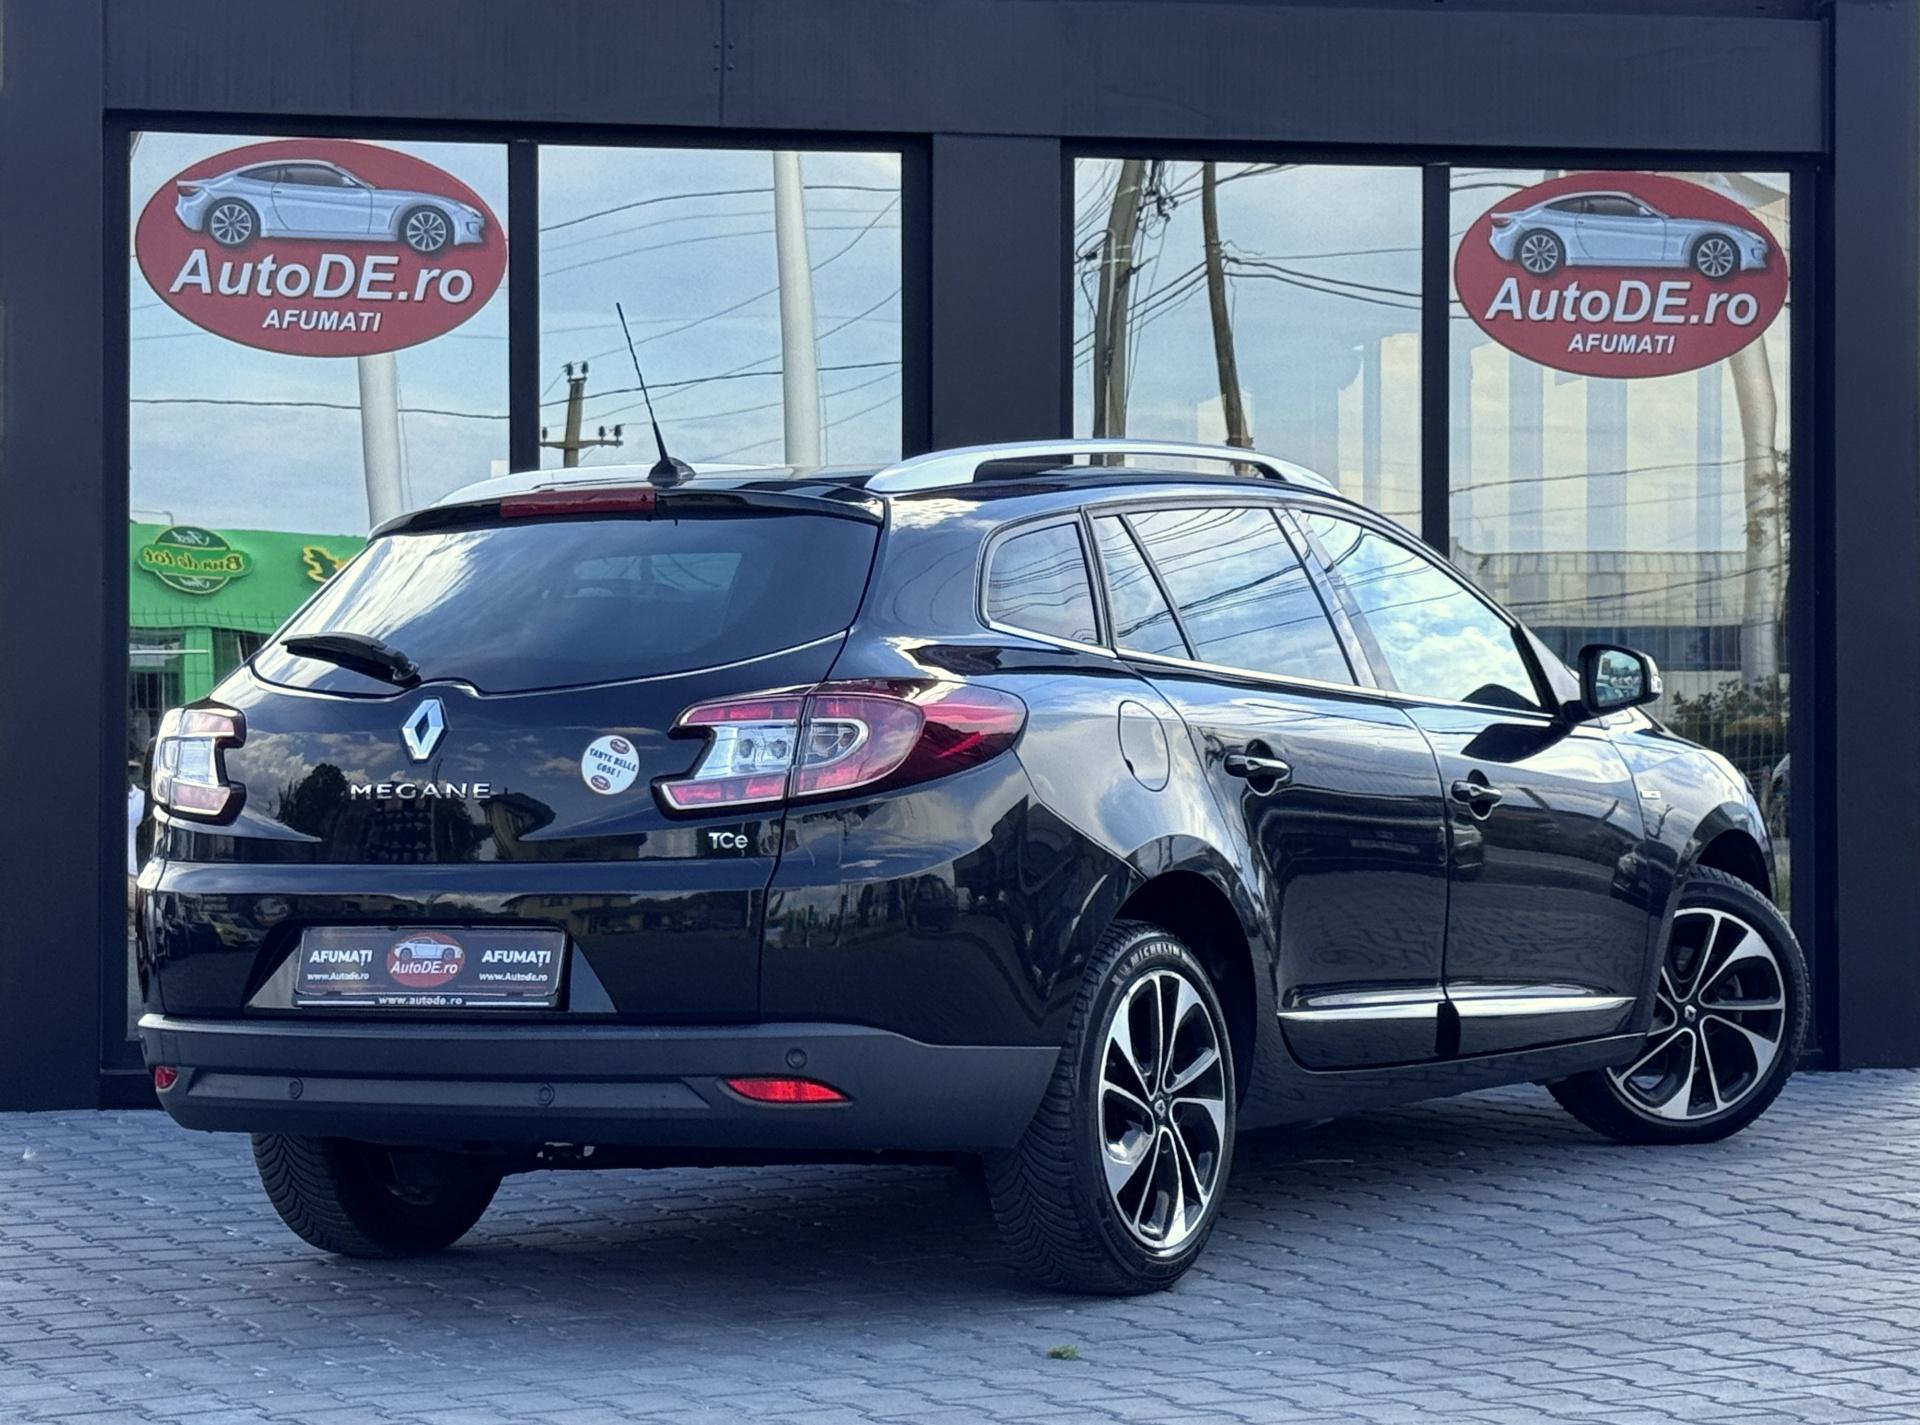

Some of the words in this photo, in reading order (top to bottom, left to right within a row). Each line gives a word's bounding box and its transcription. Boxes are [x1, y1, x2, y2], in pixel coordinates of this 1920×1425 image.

[169, 248, 474, 303] AutoDE.ro
[1484, 277, 1759, 327] AutoDE.ro
[262, 308, 382, 333] AFUMATI
[1567, 333, 1676, 355] AFUMATI
[350, 783, 492, 800] MEGANE
[708, 832, 749, 849] TCe
[389, 960, 458, 976] AutoDE.ro
[378, 995, 463, 1006] www.autode.ro
